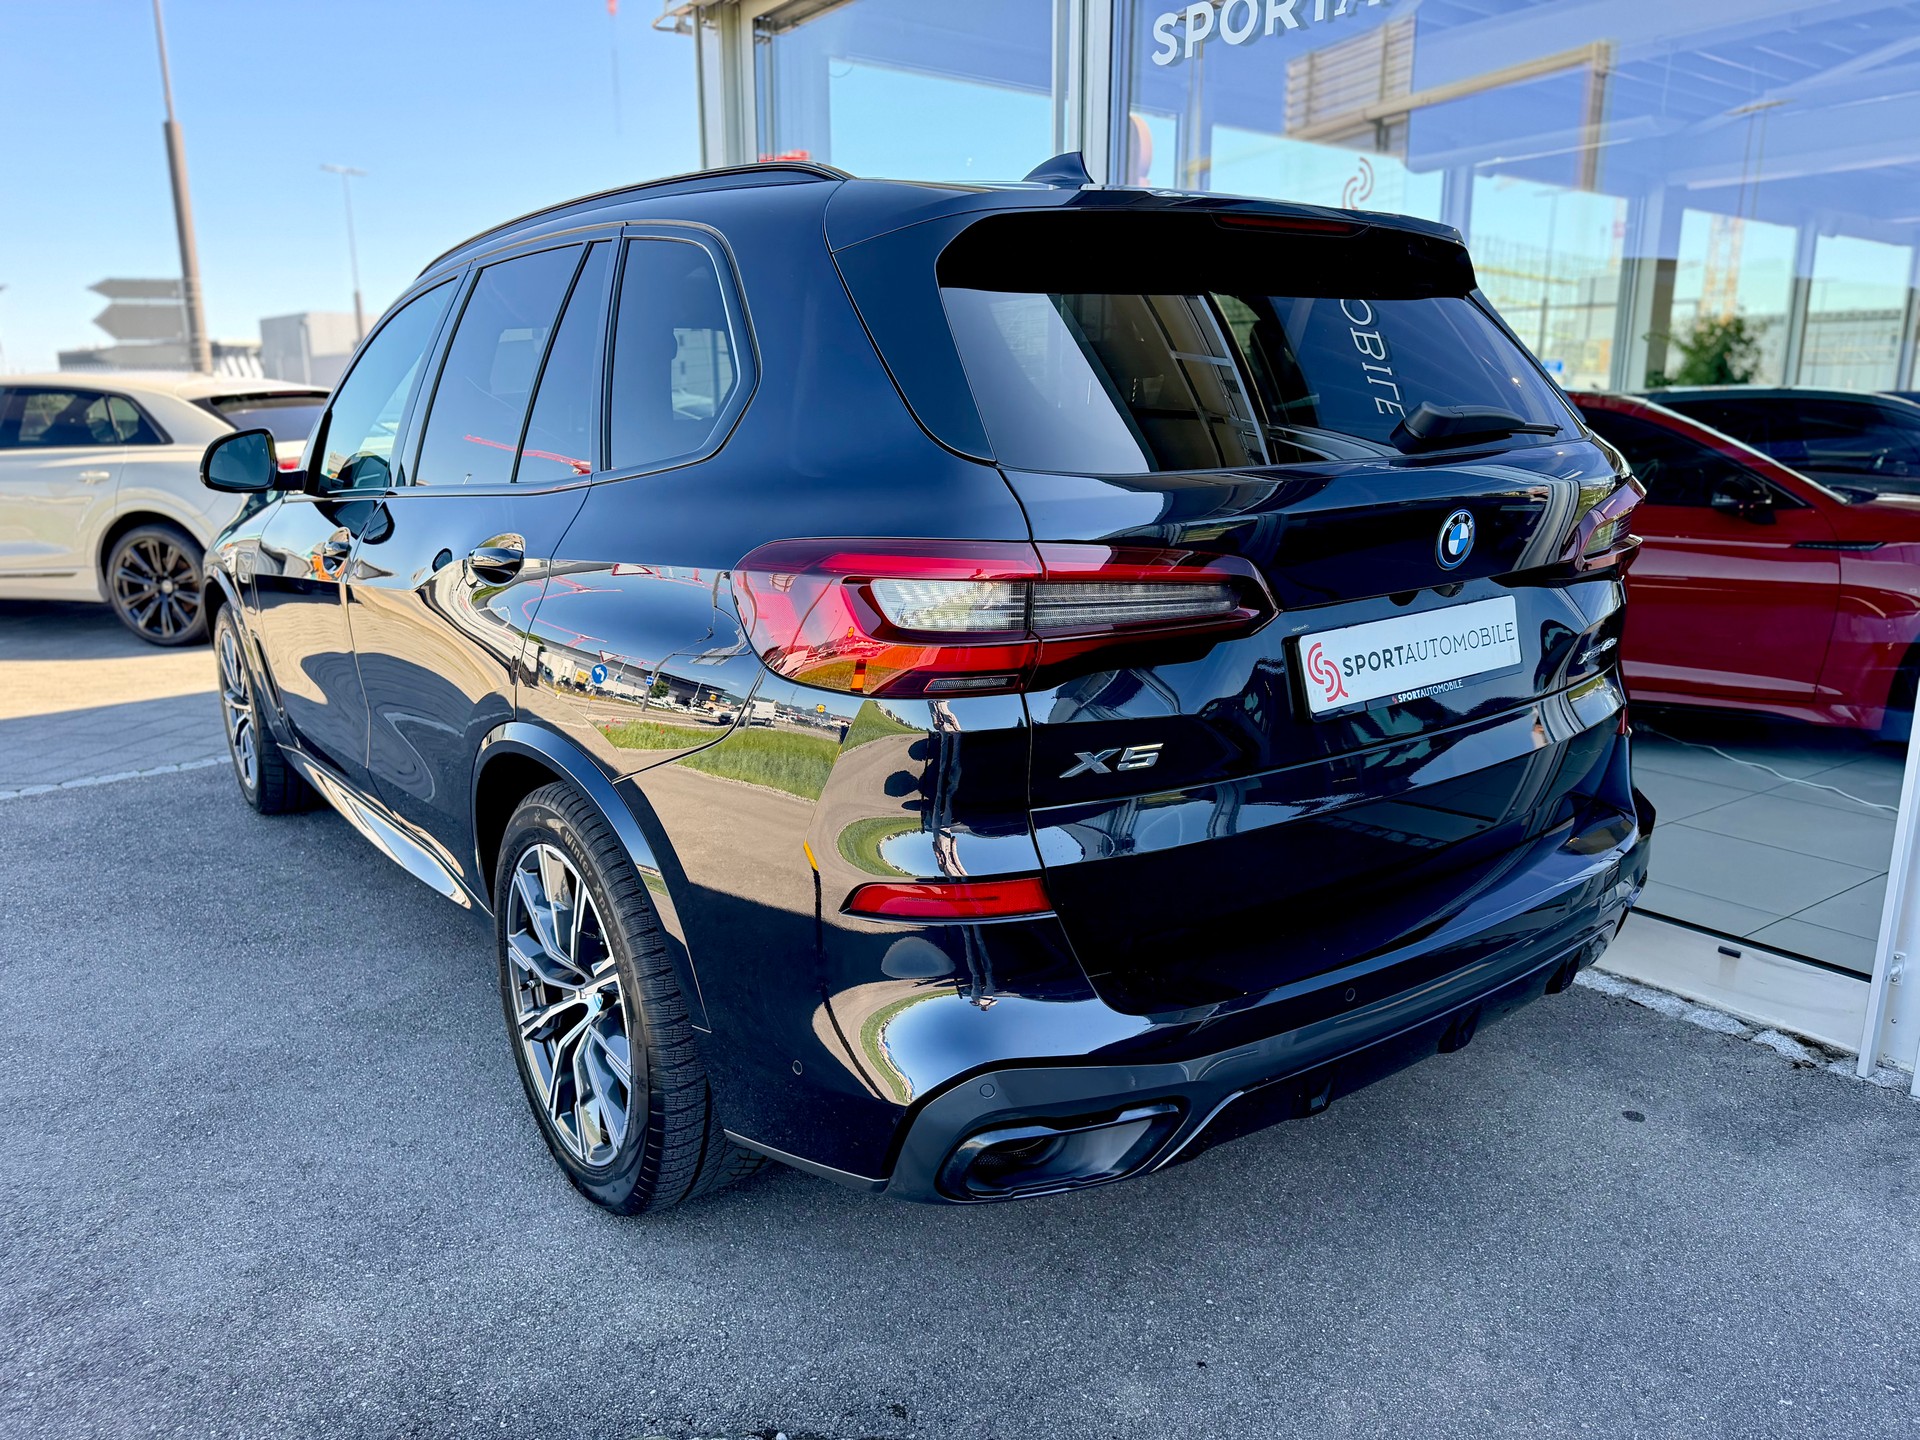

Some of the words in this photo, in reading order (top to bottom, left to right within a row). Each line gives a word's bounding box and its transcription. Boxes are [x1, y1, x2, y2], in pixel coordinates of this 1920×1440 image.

[1151, 0, 1381, 66] SPOR
[1342, 621, 1516, 678] SPORTAUTOMOBILE
[1397, 679, 1464, 703] SPORTAUTOMOBILE
[1059, 742, 1164, 779] X5
[563, 831, 593, 877] Winter
